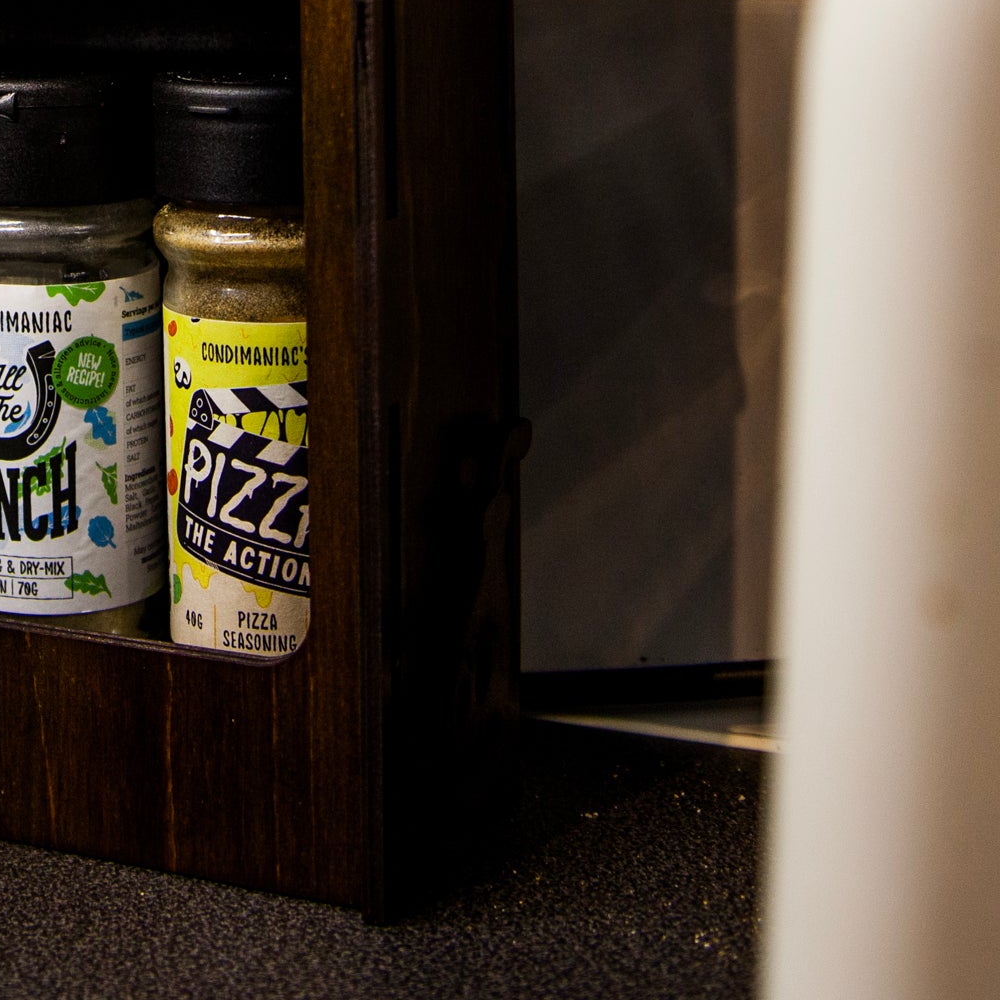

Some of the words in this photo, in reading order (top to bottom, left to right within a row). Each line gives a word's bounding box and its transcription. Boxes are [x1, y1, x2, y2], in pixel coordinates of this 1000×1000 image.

[53, 346, 74, 379] allergen
[75, 338, 102, 349] advice
[78, 352, 102, 371] NEW
[66, 366, 106, 389] RECIPE!
[127, 452, 140, 463] SALT
[185, 515, 216, 554] THE
[7, 560, 16, 573] &
[20, 561, 66, 576] DRY-MIX
[18, 581, 39, 596] 70G
[185, 609, 204, 630] 40G
[237, 611, 278, 631] PIZZA
[223, 630, 298, 652] SEASONING
